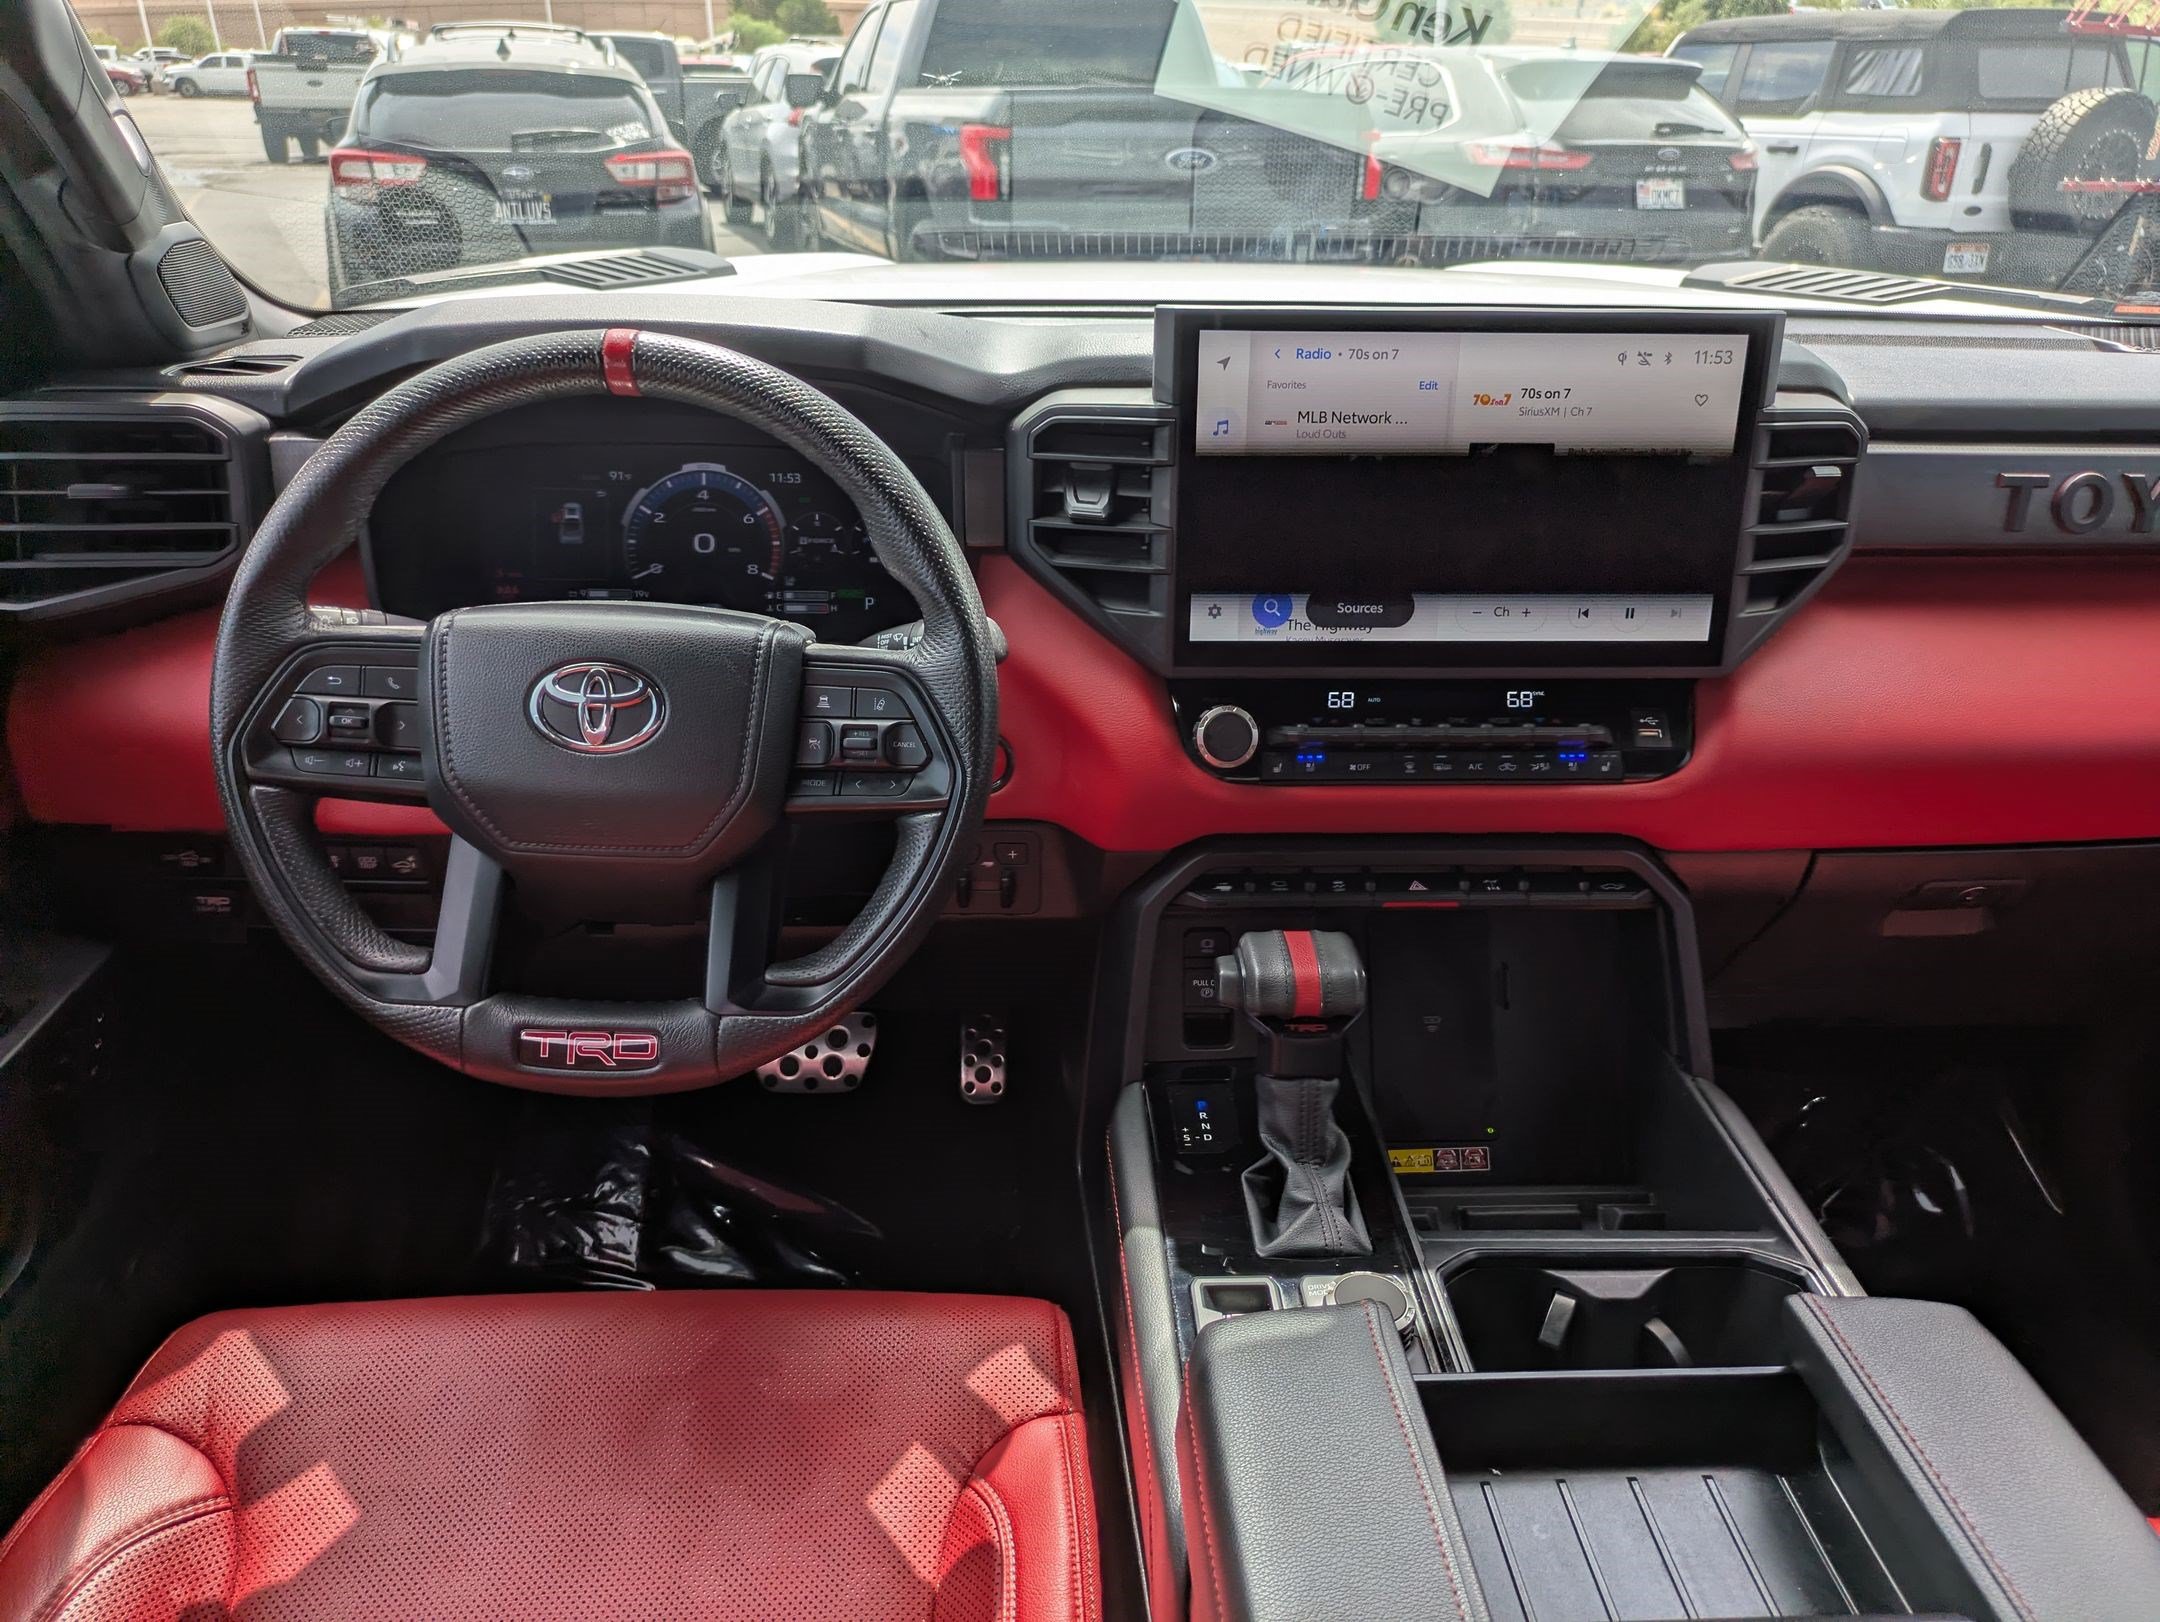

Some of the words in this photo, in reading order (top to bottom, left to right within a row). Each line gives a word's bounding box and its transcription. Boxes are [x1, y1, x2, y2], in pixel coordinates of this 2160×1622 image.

[1295, 348, 1332, 360] Radio
[1348, 349, 1370, 360] 70s
[1372, 351, 1389, 360] on
[1391, 349, 1400, 360] 7
[1693, 350, 1734, 365] 11:53
[1266, 380, 1307, 390] Favorites
[1418, 380, 1439, 391] Edit
[1520, 388, 1542, 399] 70s
[1544, 390, 1560, 399] on
[1563, 388, 1571, 399] 7
[1518, 406, 1560, 417] SiriusXM
[1570, 406, 1585, 417] Ch
[1586, 407, 1593, 417] 7
[1297, 411, 1328, 424] MLB
[1330, 411, 1392, 424] Network
[1296, 429, 1320, 439] Loud
[1322, 429, 1347, 439] Outs
[769, 473, 801, 484] 11:53
[697, 490, 709, 500] 4
[653, 512, 666, 523] 2
[743, 513, 755, 524] 6
[694, 533, 715, 553] 0
[747, 564, 759, 575] 8
[831, 604, 838, 612] H
[864, 597, 875, 611] P
[1336, 602, 1384, 614] Sources
[1493, 606, 1510, 617] Ch
[1286, 619, 1311, 631] The
[1327, 691, 1355, 708] 68
[1506, 691, 1533, 708] 68
[341, 717, 353, 725] OK
[893, 741, 916, 749] CANCEL
[1357, 763, 1371, 771] OFF
[1468, 763, 1484, 771] A/C
[1192, 979, 1209, 987] PULL
[520, 1029, 658, 1066] TRD
